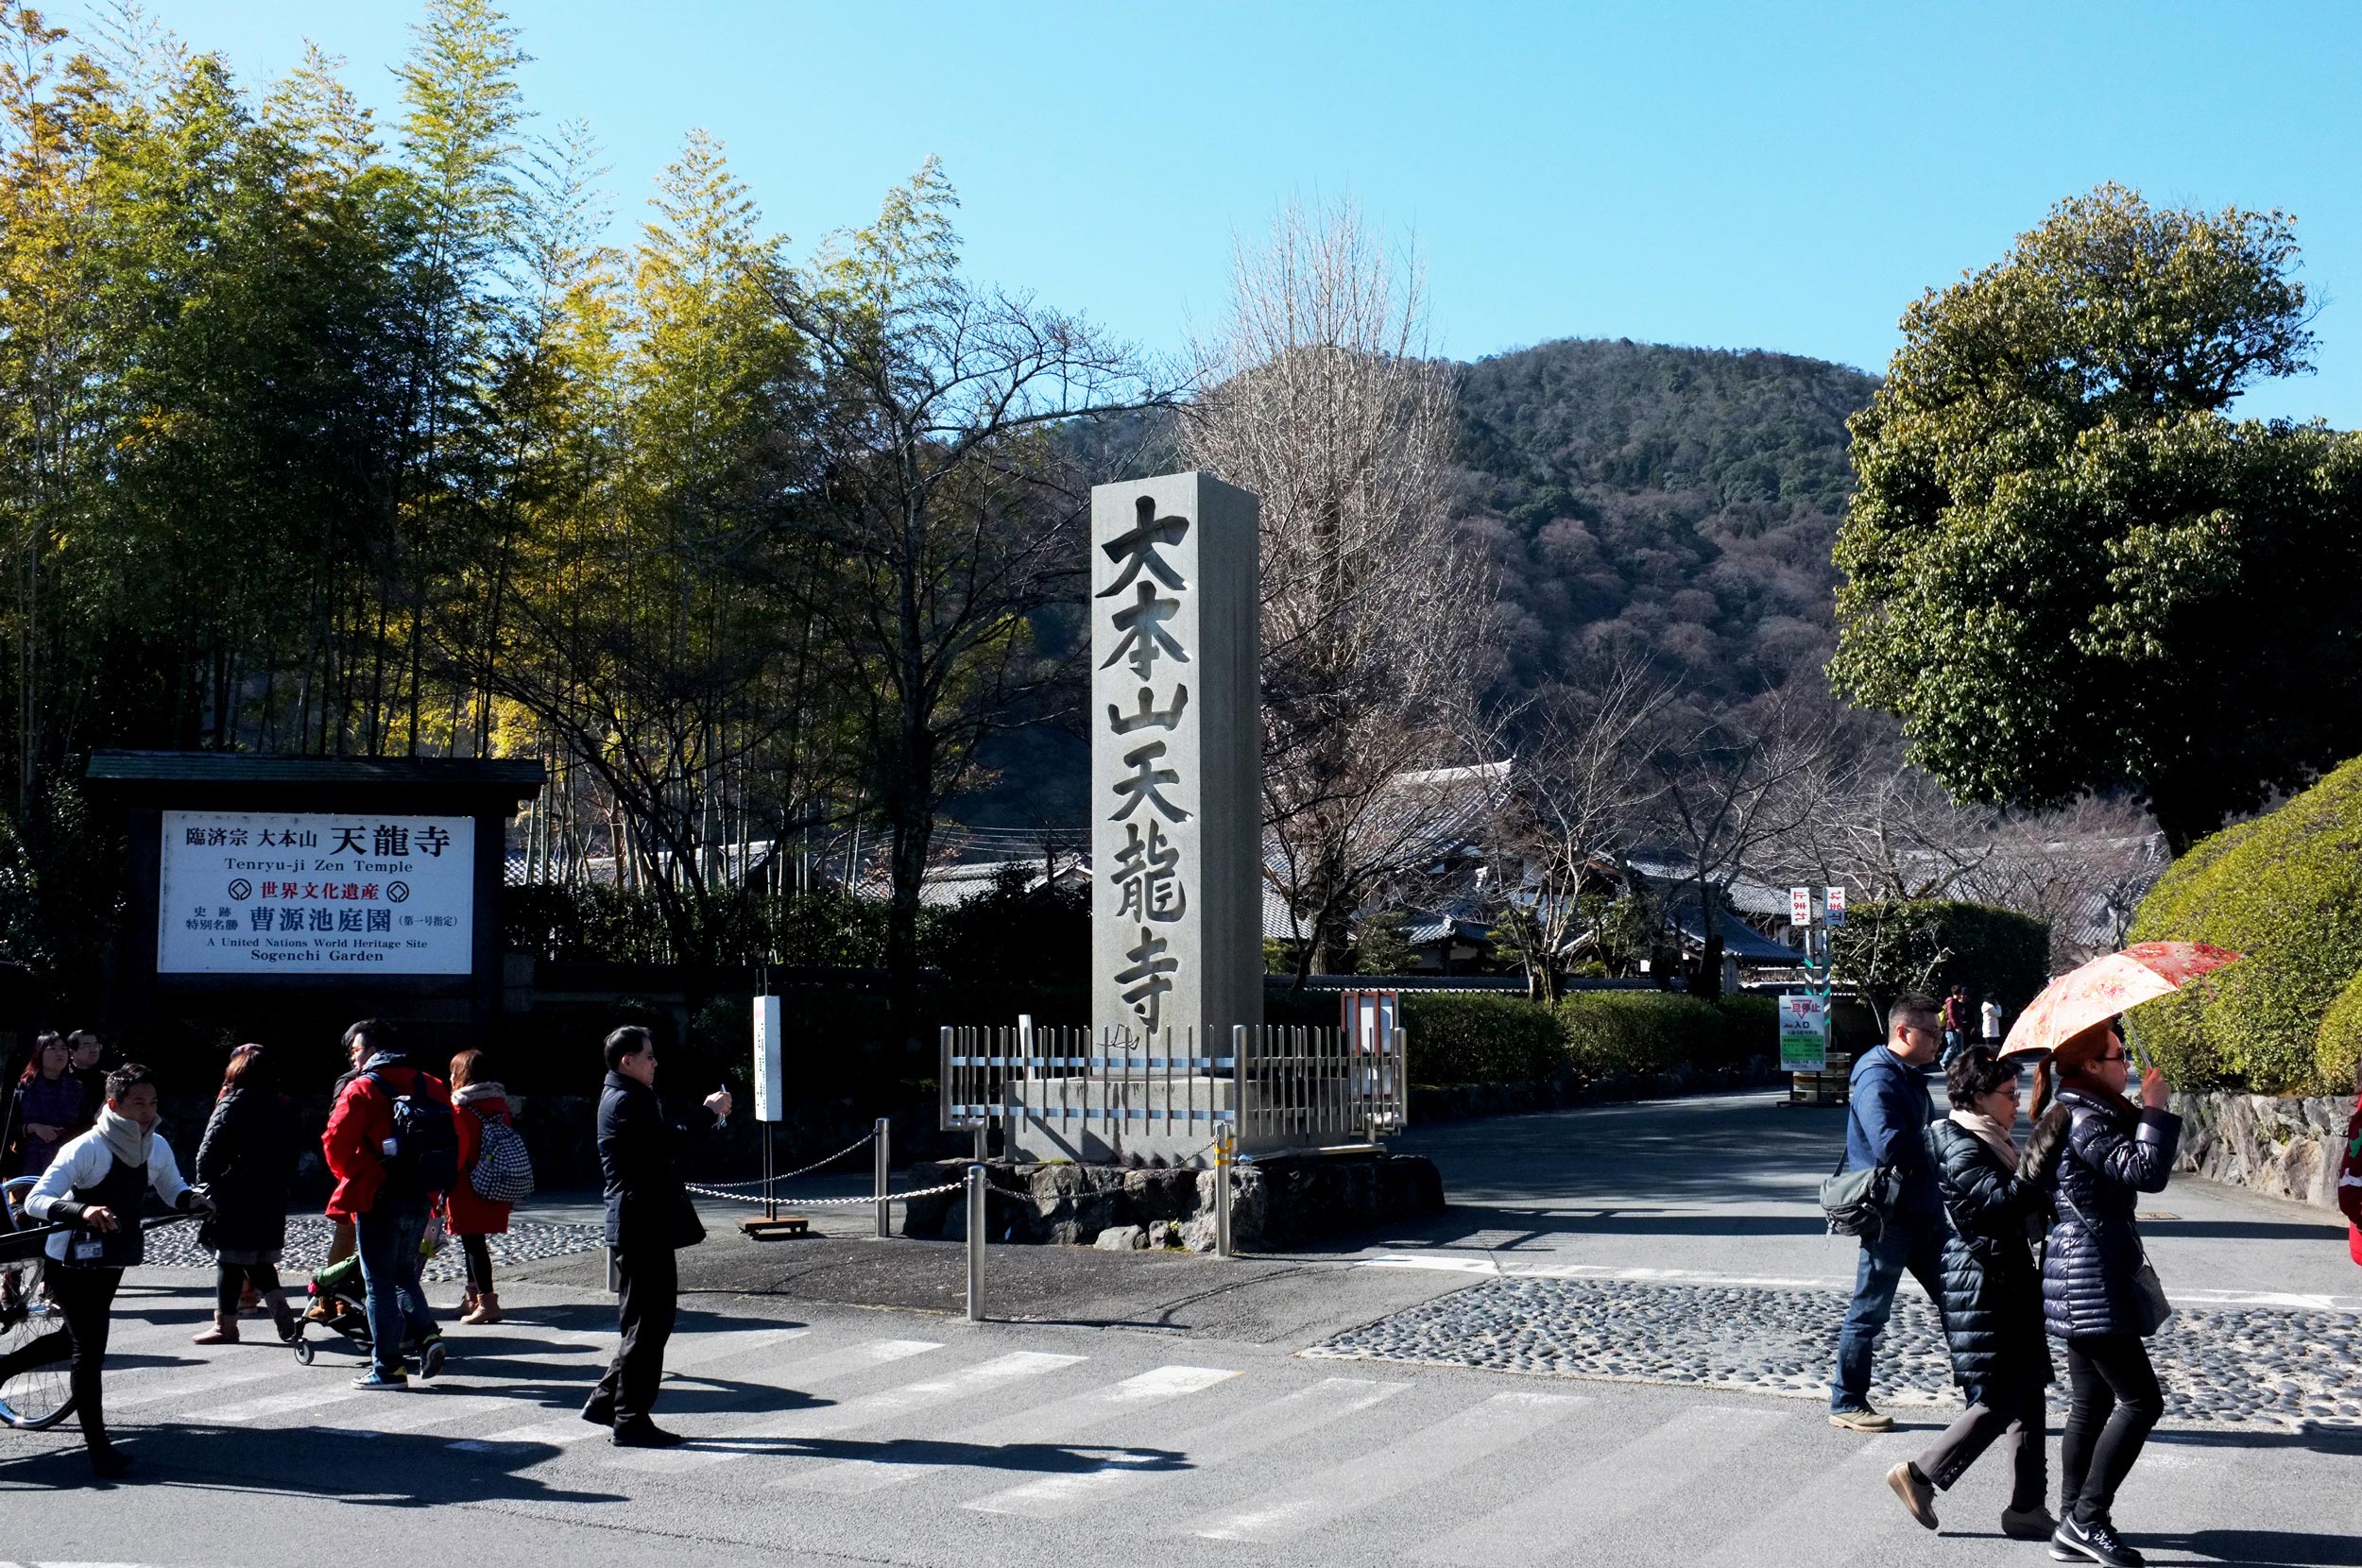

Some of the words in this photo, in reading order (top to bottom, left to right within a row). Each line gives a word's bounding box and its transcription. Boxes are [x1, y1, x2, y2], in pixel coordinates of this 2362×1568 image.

[1095, 495, 1193, 1034] 大本山天龍寺
[186, 827, 248, 846] 臨済宗
[257, 828, 317, 848] 大本山
[330, 825, 450, 858] 天龍寺
[225, 858, 305, 873] Tenryu-ji
[315, 860, 344, 872] Zen
[354, 861, 413, 874] Temple
[260, 881, 379, 900] 世界文化遺産
[186, 919, 238, 930] 特別名勝
[249, 906, 391, 933] 曹源池庭園
[207, 938, 215, 946] A
[222, 938, 260, 947] United
[265, 938, 308, 947] Nations
[314, 939, 348, 948] World
[353, 940, 402, 949] Heritage
[406, 940, 428, 948] Site
[250, 949, 320, 963] Sogenchi
[329, 950, 384, 962] Garden
